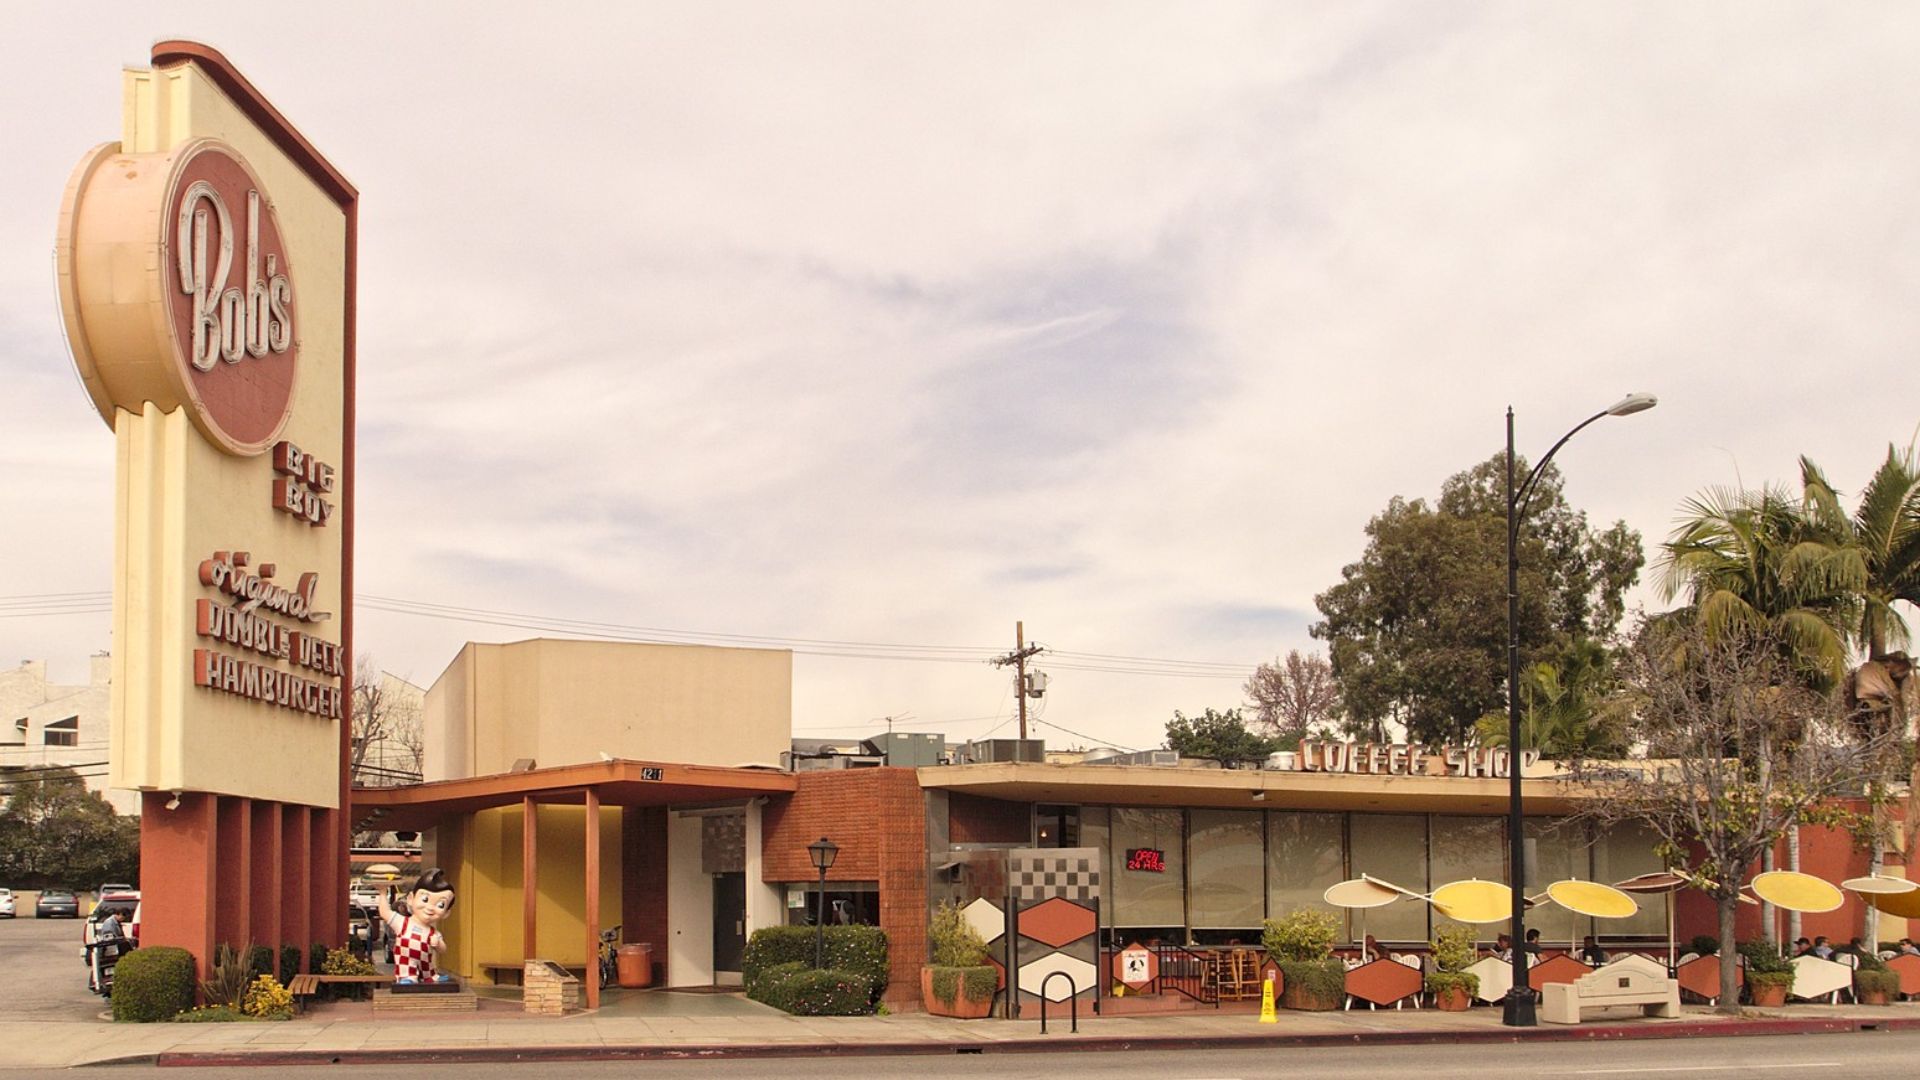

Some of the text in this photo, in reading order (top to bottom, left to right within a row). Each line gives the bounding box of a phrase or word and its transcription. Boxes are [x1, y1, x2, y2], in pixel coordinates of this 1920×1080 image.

[178, 180, 290, 372] Bob's
[277, 441, 334, 493] BIG
[277, 480, 335, 526] BOY
[202, 600, 345, 677] DOUBLE DECK
[199, 649, 344, 719] HAMBURGER
[1301, 739, 1540, 779] COFFEE SHOP
[1128, 860, 1166, 871] 24 HRS
[1135, 850, 1159, 861] OPEN
